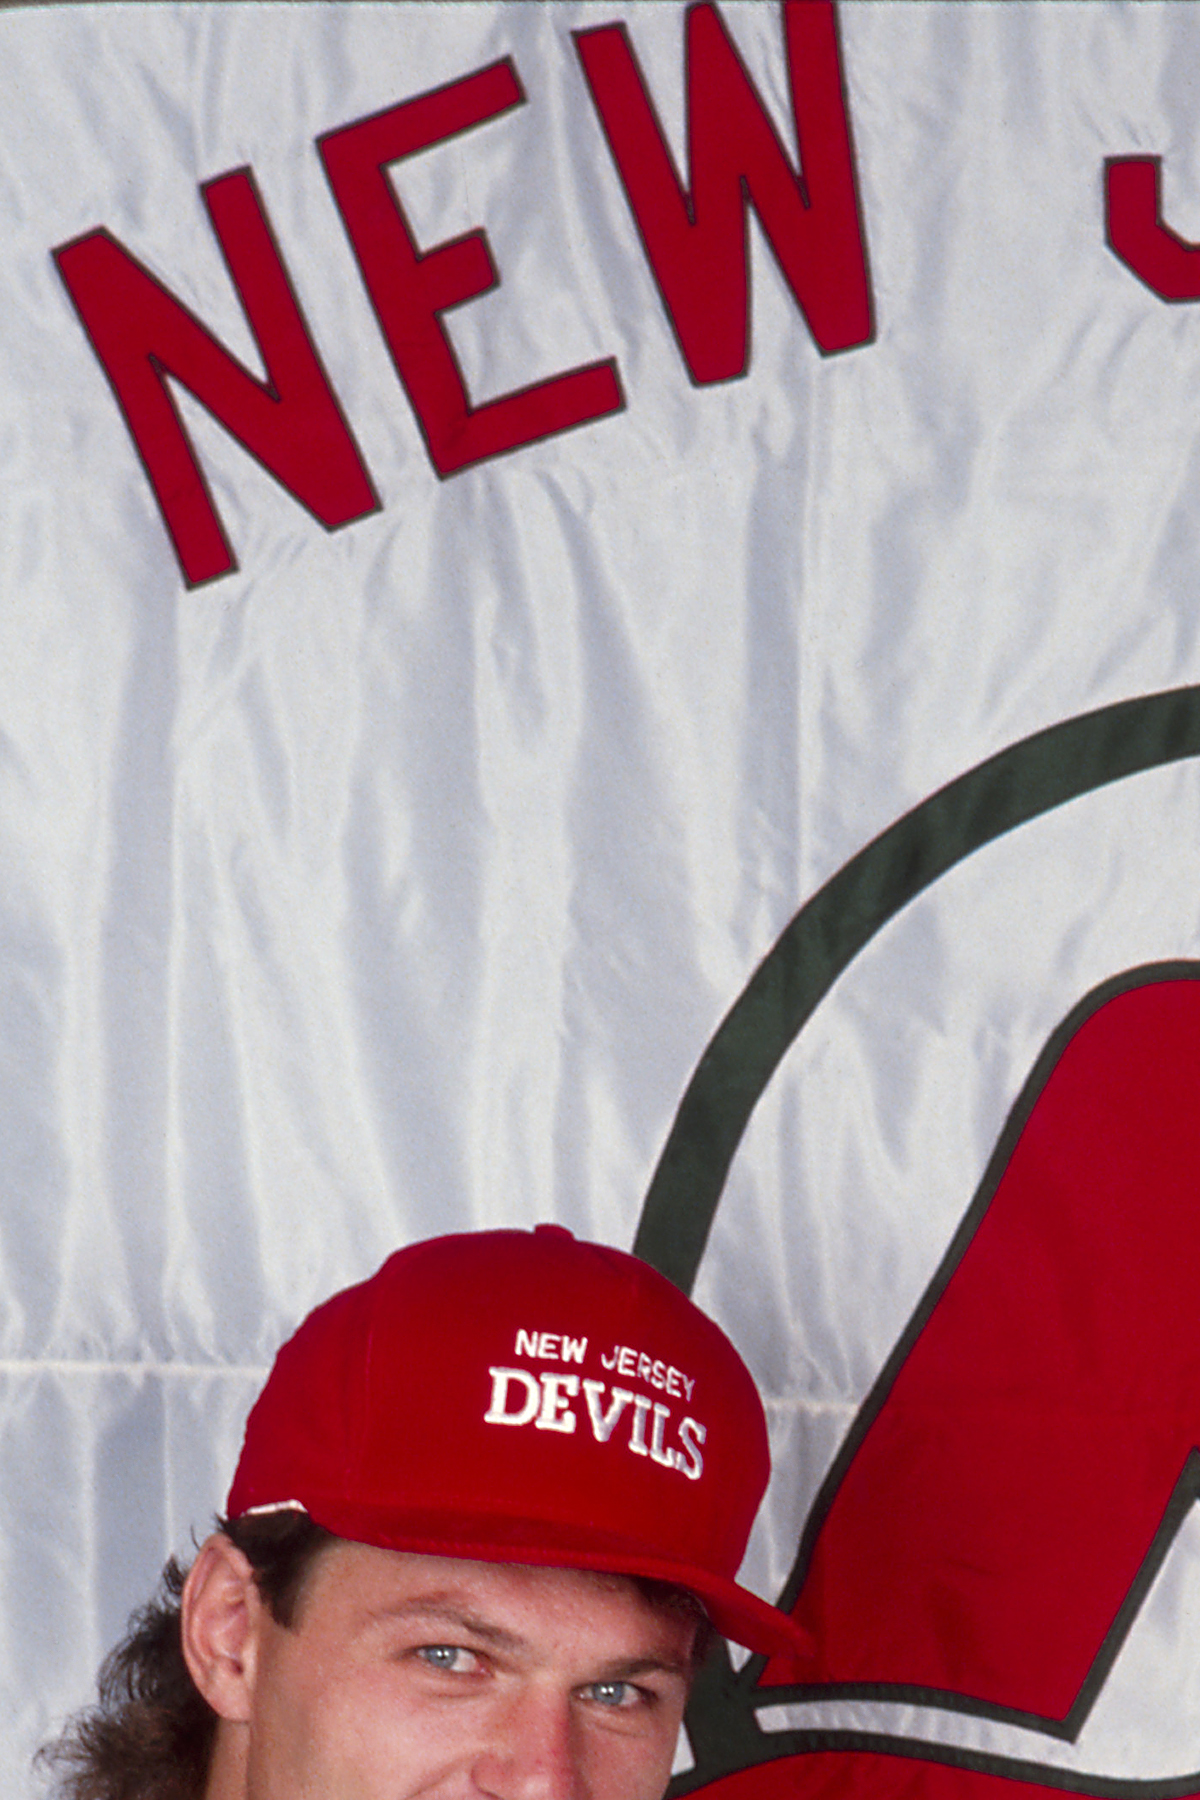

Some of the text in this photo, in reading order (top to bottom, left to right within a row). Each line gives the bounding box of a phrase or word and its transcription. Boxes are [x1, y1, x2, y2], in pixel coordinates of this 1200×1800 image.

[50, 0, 877, 590] NEW
[514, 1328, 696, 1402] NEW JERSEY
[483, 1366, 707, 1481] DEVILS
